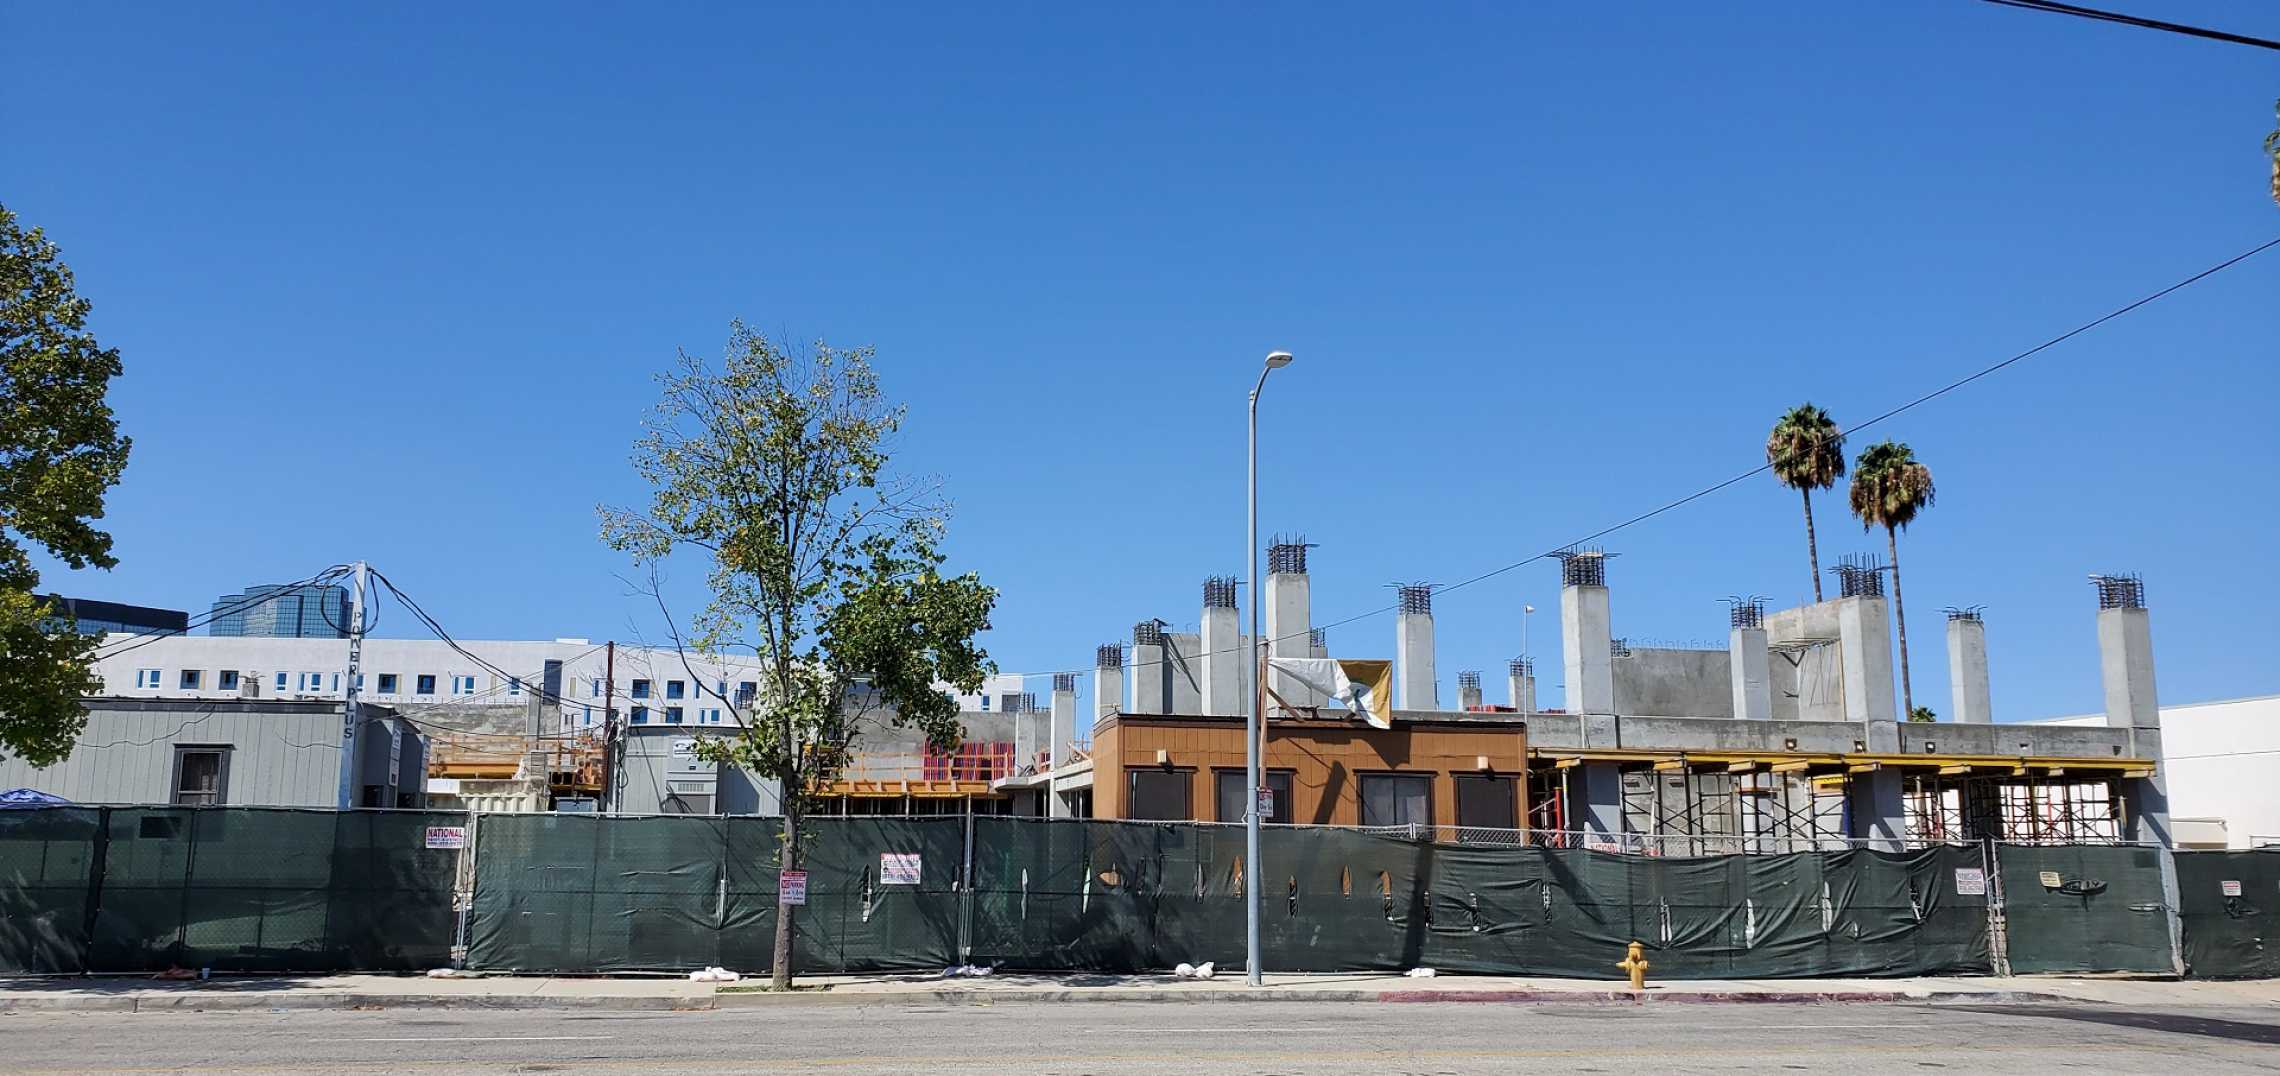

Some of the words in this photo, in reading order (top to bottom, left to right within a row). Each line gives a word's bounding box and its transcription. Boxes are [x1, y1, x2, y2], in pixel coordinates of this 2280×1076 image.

[349, 611, 362, 676] POWER
[343, 687, 356, 739] PLUS
[428, 828, 463, 837] NATIONAL
